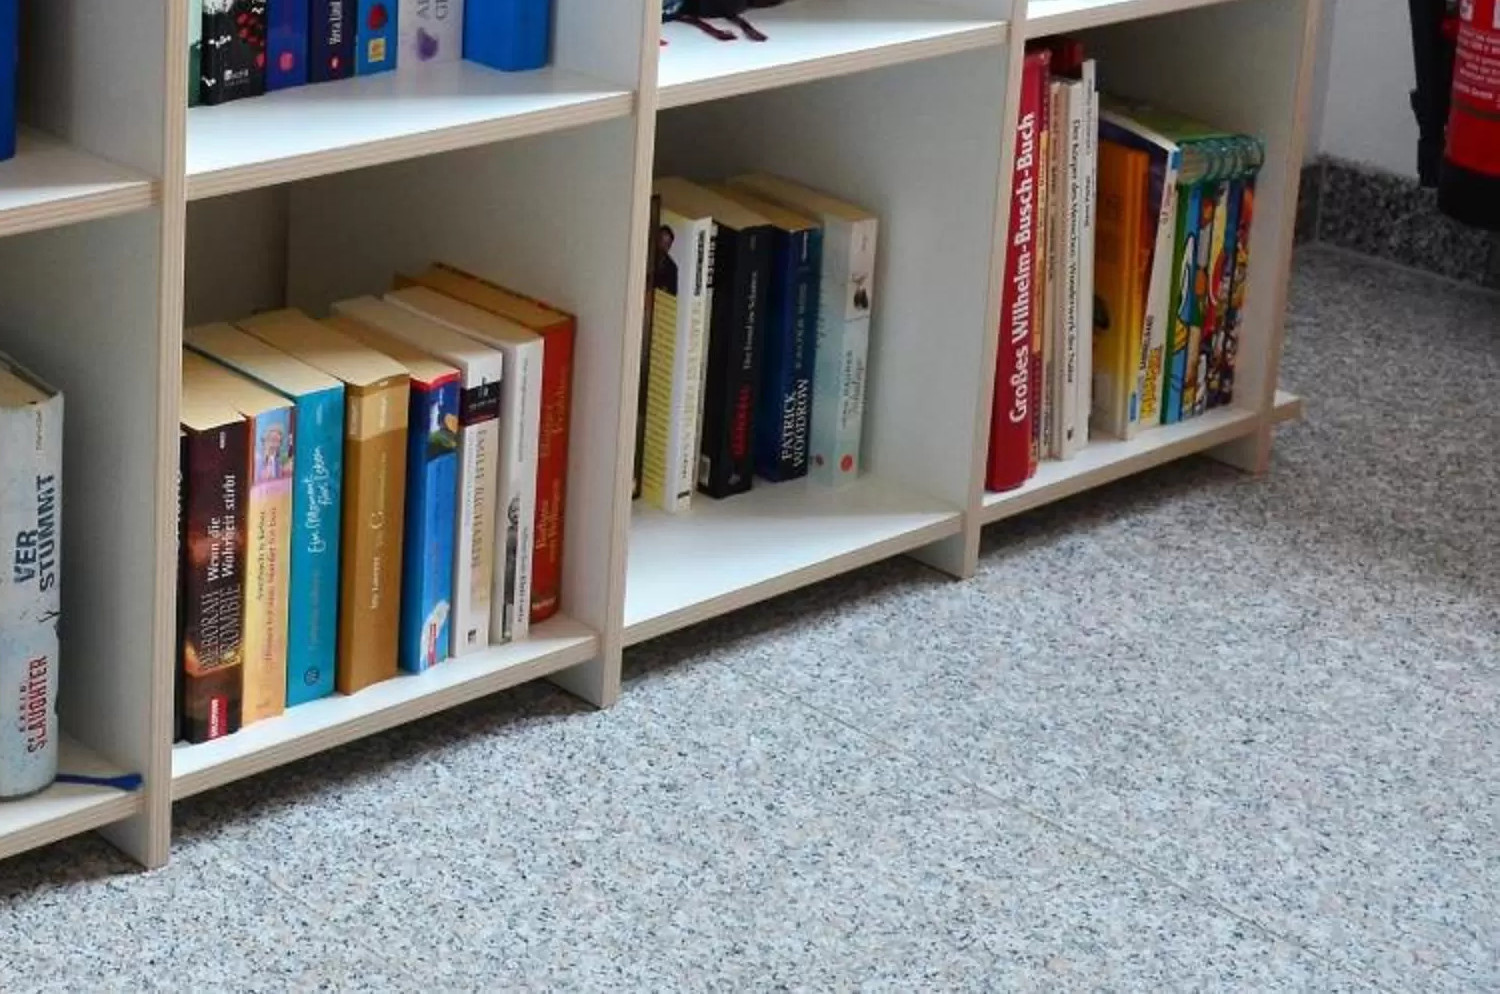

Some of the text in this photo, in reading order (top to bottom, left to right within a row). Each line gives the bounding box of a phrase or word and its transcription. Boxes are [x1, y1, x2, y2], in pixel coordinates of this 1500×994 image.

[1009, 112, 1035, 423] Großes Wilhelm-Busch-Buch
[782, 392, 797, 462] PATRICK
[13, 530, 37, 583] VER
[36, 474, 55, 592] STUMMT
[207, 517, 220, 582] Wenn die
[221, 475, 236, 579] Wahrheit stirbt
[200, 591, 219, 669] DEBORAH
[218, 584, 241, 664] CROMBIE
[26, 655, 48, 753] SLAUGHTER
